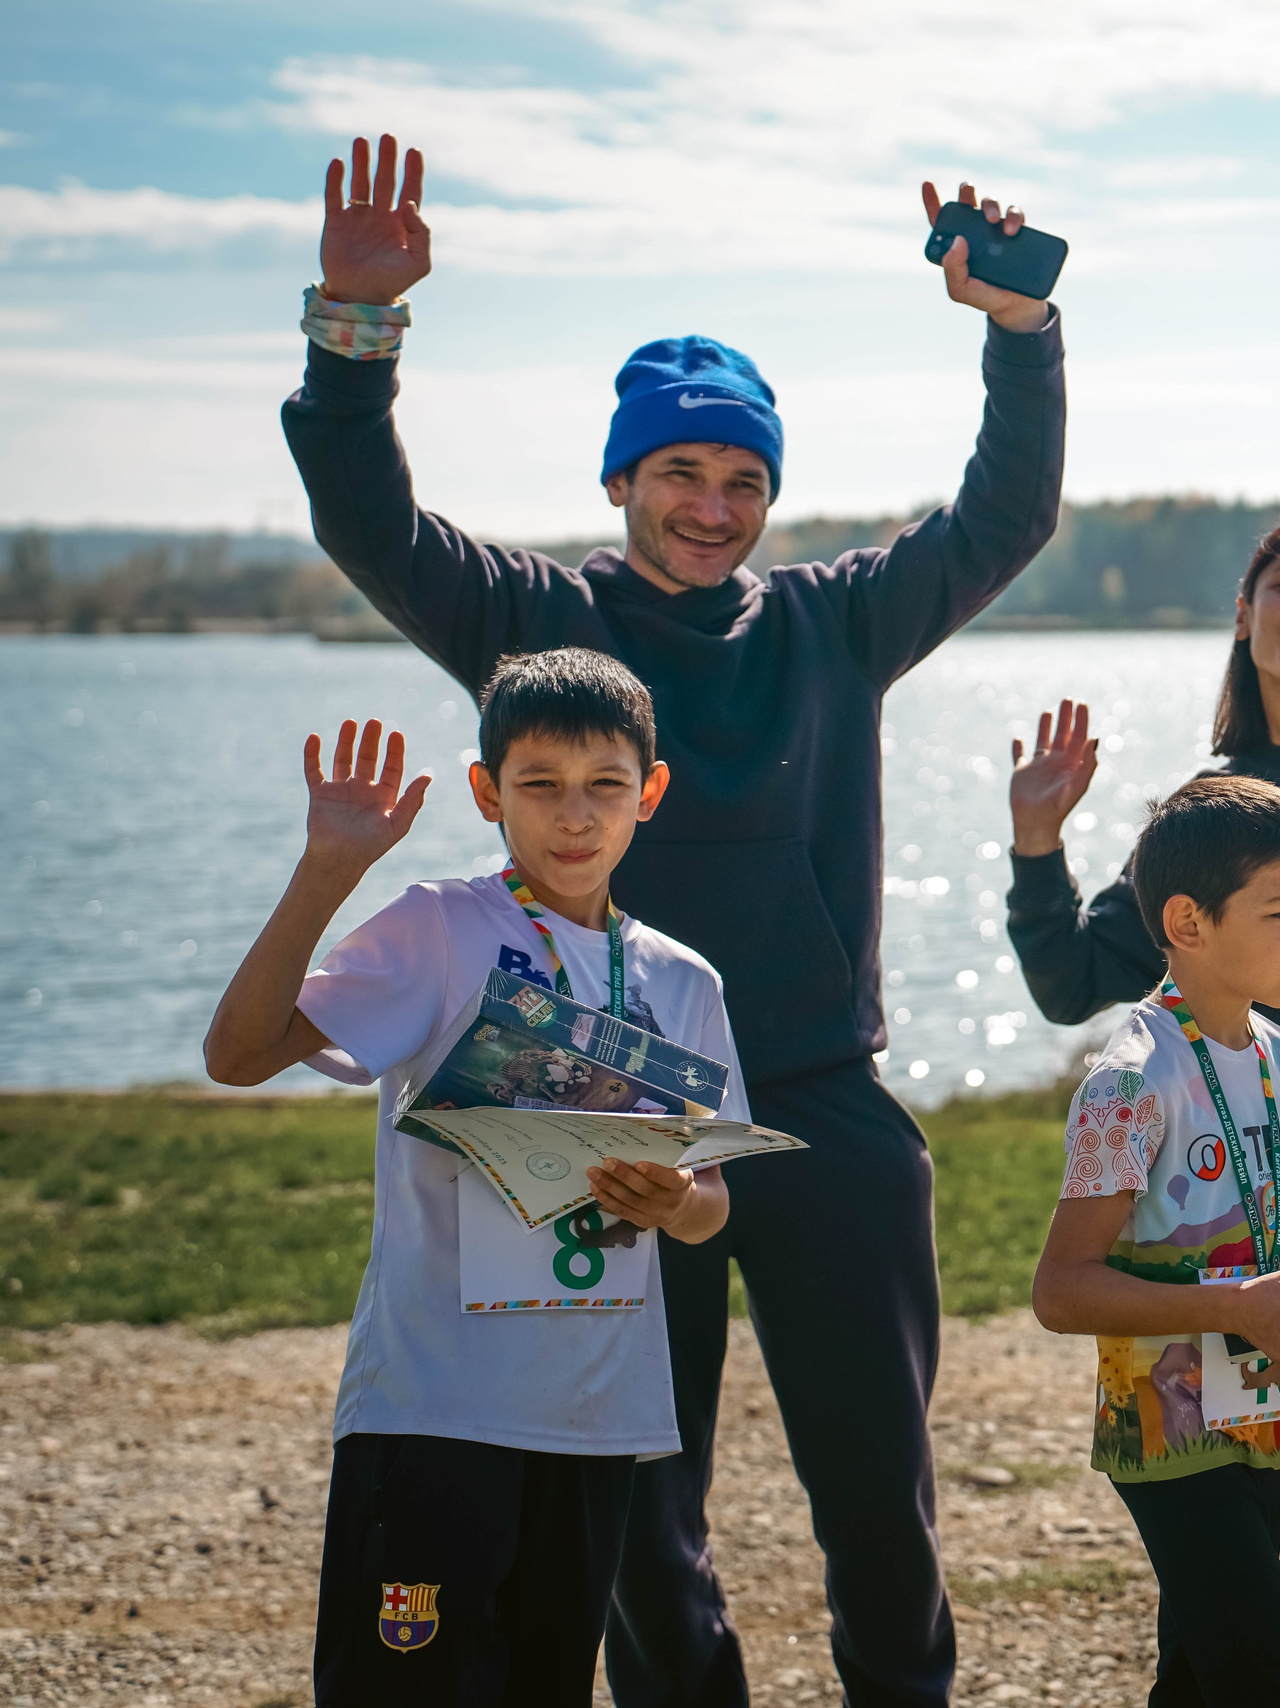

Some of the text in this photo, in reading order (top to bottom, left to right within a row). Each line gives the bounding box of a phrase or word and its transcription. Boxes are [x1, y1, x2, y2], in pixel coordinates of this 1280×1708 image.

[612, 966, 622, 988] ТРЕЙЛ
[614, 990, 622, 1018] ЕТСКИЙ
[1215, 1093, 1247, 1184] Karras ДЕТСКИЙ ТРЕЙЛ
[493, 1151, 508, 1165] 2025
[553, 1209, 605, 1290] 8
[1255, 1234, 1264, 1261] Karras
